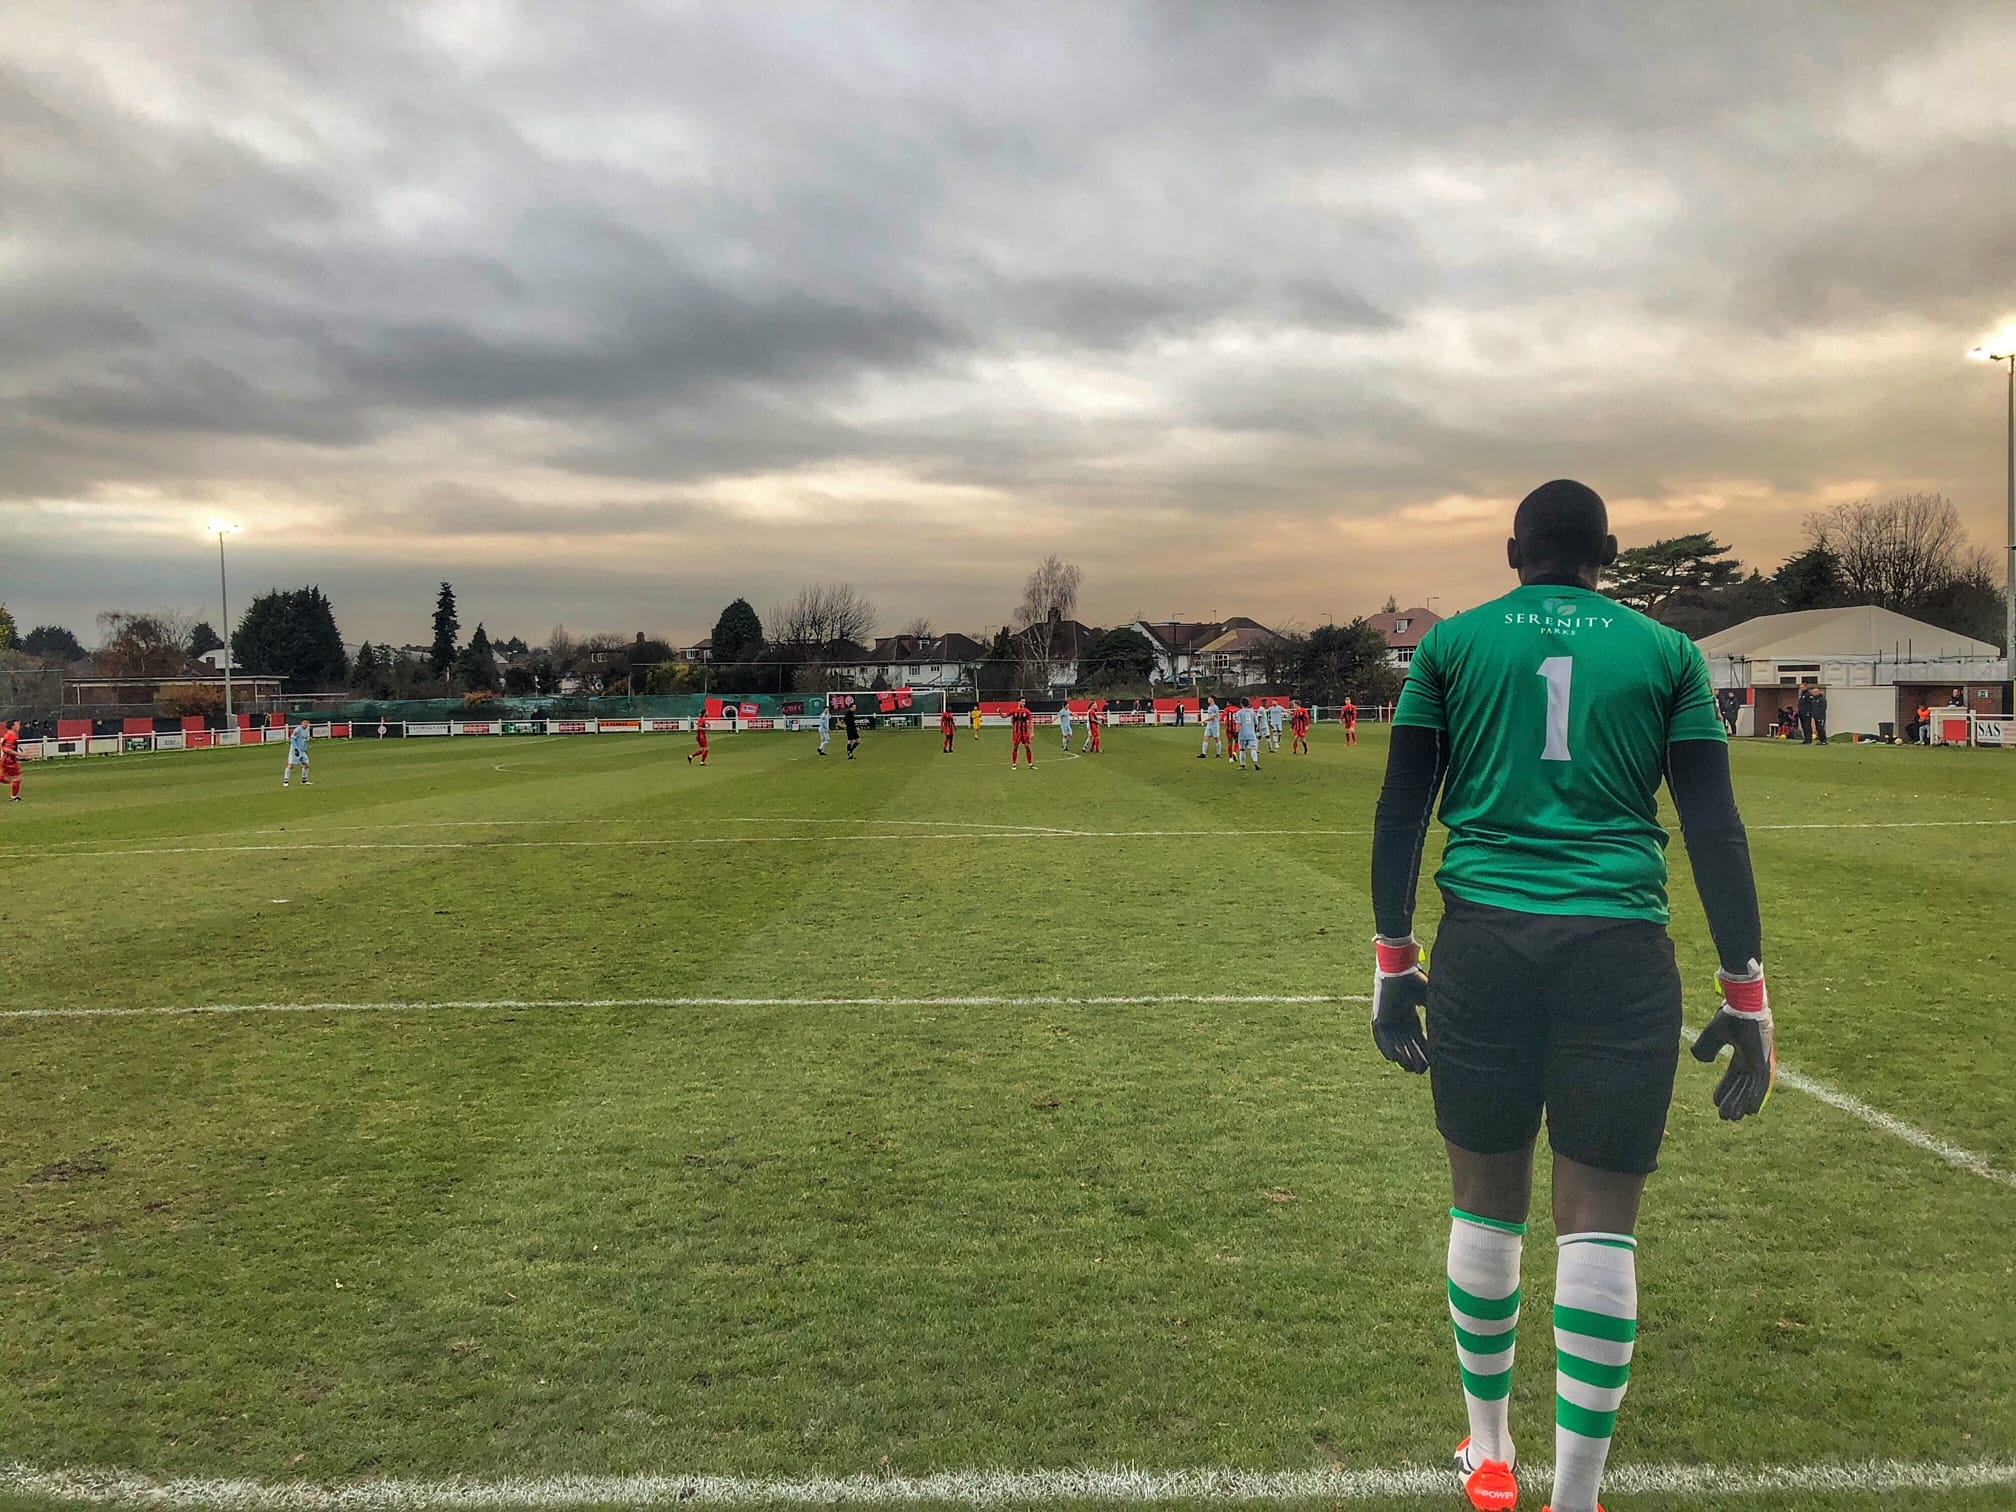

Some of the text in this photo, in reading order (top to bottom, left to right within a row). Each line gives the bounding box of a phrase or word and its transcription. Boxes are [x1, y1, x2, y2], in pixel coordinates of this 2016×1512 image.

[1504, 613, 1613, 628] SERENITY
[1540, 627, 1577, 636] PARKS
[1536, 655, 1573, 761] 1
[1245, 711, 1252, 724] 9
[1978, 722, 2001, 737] SAS
